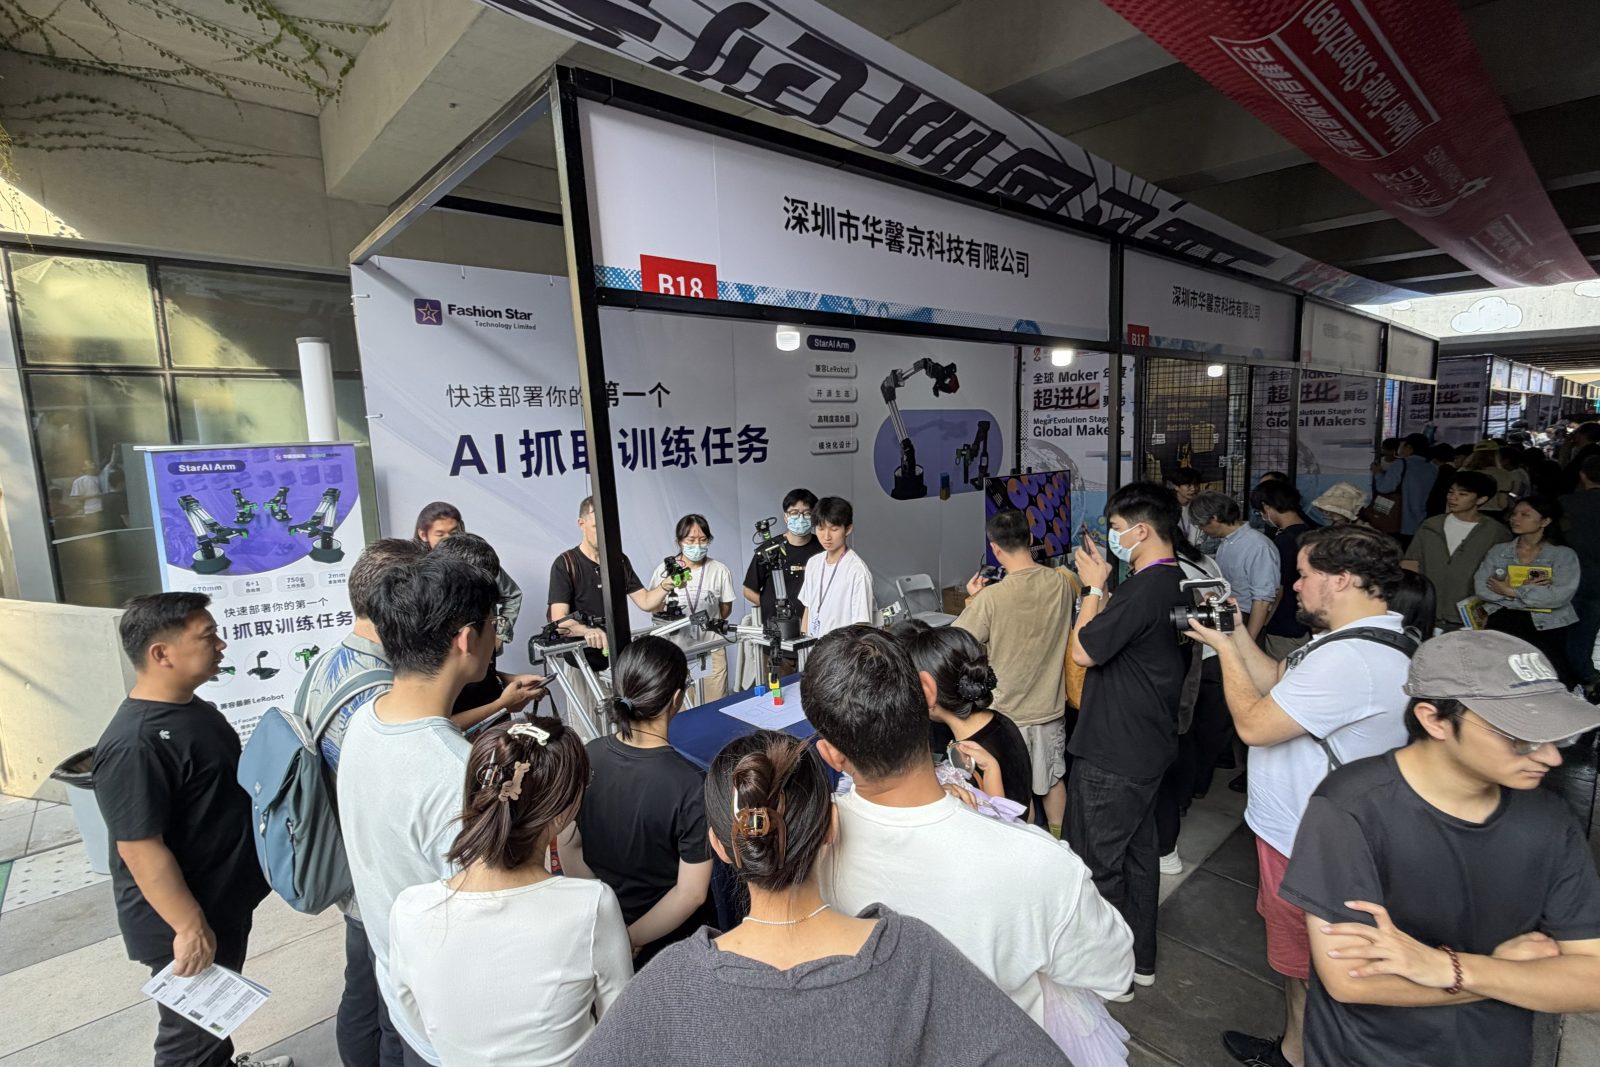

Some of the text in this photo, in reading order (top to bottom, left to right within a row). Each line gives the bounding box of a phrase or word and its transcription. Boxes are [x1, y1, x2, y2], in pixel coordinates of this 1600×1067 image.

[1303, 0, 1424, 147] Maker Faire Shenzhen
[783, 195, 1030, 279] 深圳市华馨京科技有限公司
[658, 273, 702, 297] B18
[1172, 285, 1261, 322] 深圳市华馨京科技有限公司
[447, 303, 534, 321] Fashion Star
[474, 320, 537, 331] Technology Limited
[814, 338, 850, 350] StarAI Arm
[1131, 333, 1146, 347] B17
[1033, 372, 1054, 385] 全球
[1058, 370, 1099, 383] Maker
[1033, 385, 1100, 411] 超进化
[1327, 408, 1352, 416] Stage
[1266, 415, 1367, 428] Gloal Makers
[1033, 424, 1125, 437] Global Makes
[178, 462, 237, 473] StarAI Arm
[245, 579, 260, 588] 6+1
[286, 576, 304, 585] 750g
[223, 597, 329, 618] 快速部署你的第一个
[232, 610, 354, 641] 抓取训练任务
[252, 693, 285, 706] LeRobot
